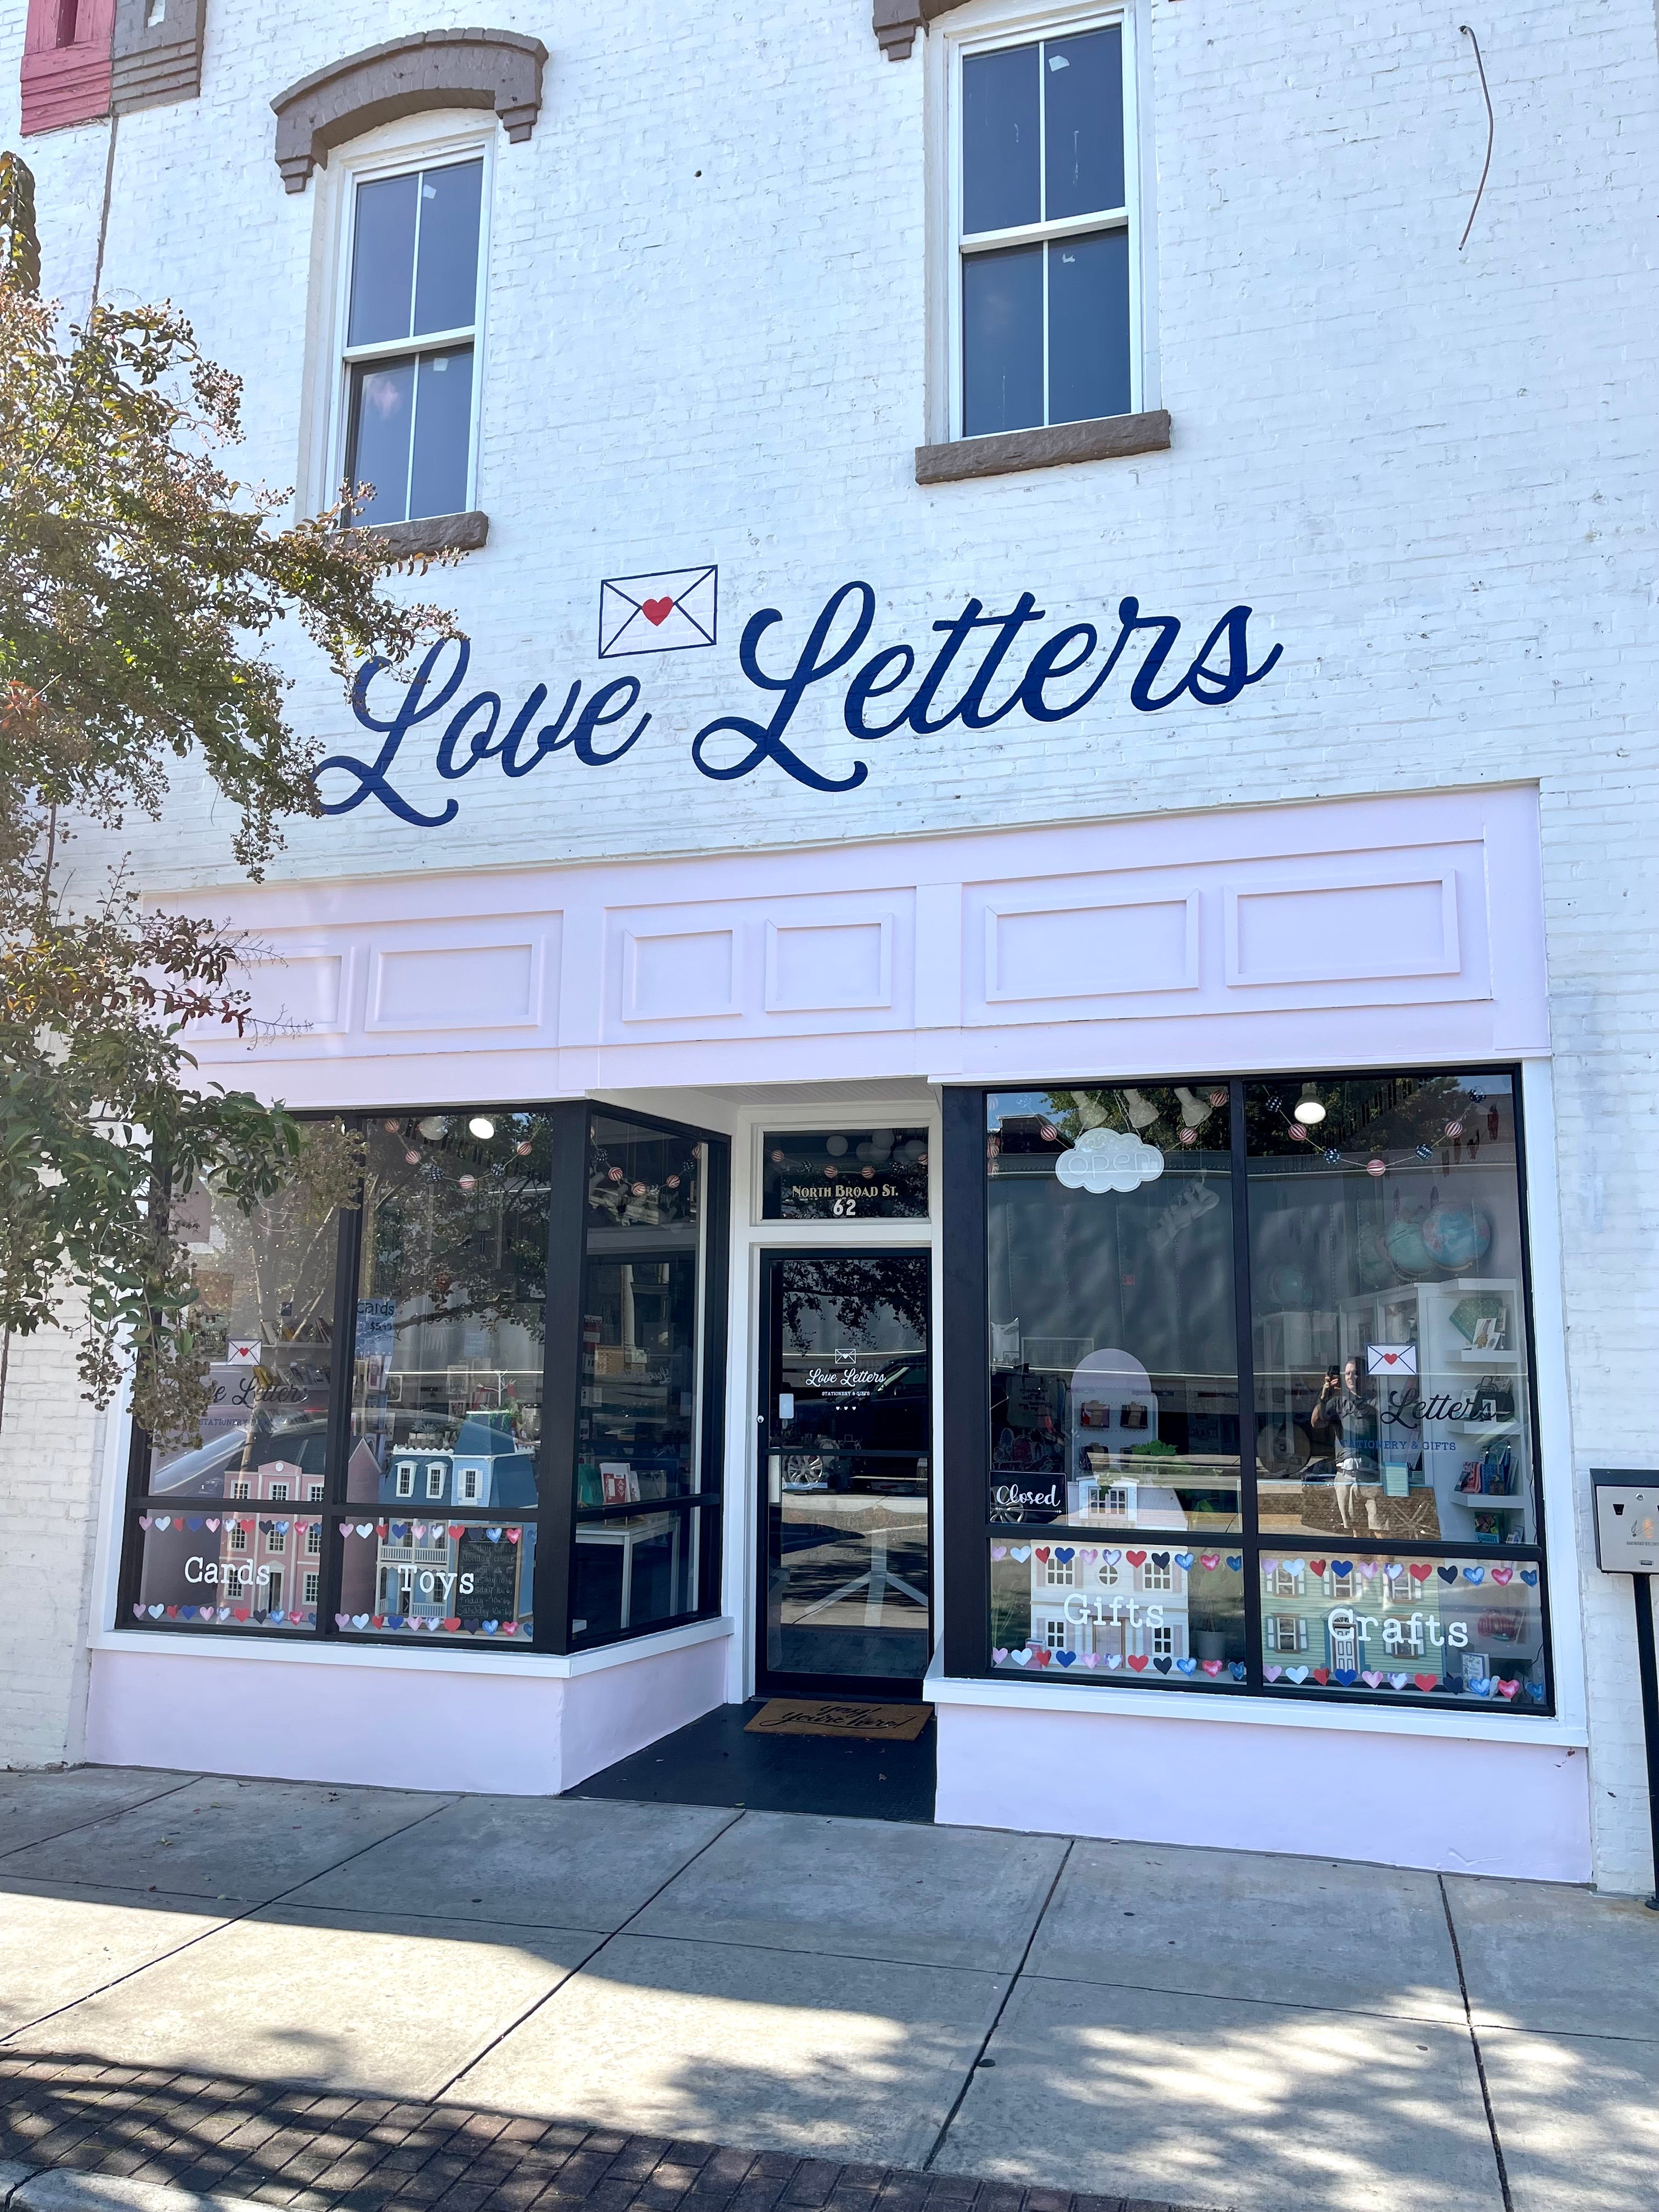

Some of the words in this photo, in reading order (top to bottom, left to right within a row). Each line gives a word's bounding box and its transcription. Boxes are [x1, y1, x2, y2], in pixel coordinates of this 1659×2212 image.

[309, 636, 652, 827] Love
[692, 580, 1284, 792] Letters
[1068, 1152, 1150, 1180] open
[792, 1185, 832, 1197] NORTH
[835, 1184, 878, 1198] BROAD
[833, 1199, 856, 1216] 62
[805, 1368, 838, 1387] Love
[840, 1368, 887, 1387] Letters
[1380, 1387, 1497, 1429] Letters
[1410, 1441, 1419, 1449] &
[1422, 1442, 1457, 1451] GIFTS
[996, 1483, 1061, 1507] Closed
[184, 1556, 270, 1586] Cards
[397, 1565, 475, 1600] Toys
[1064, 1593, 1165, 1629] Gifts
[1328, 1608, 1469, 1648] Crafts
